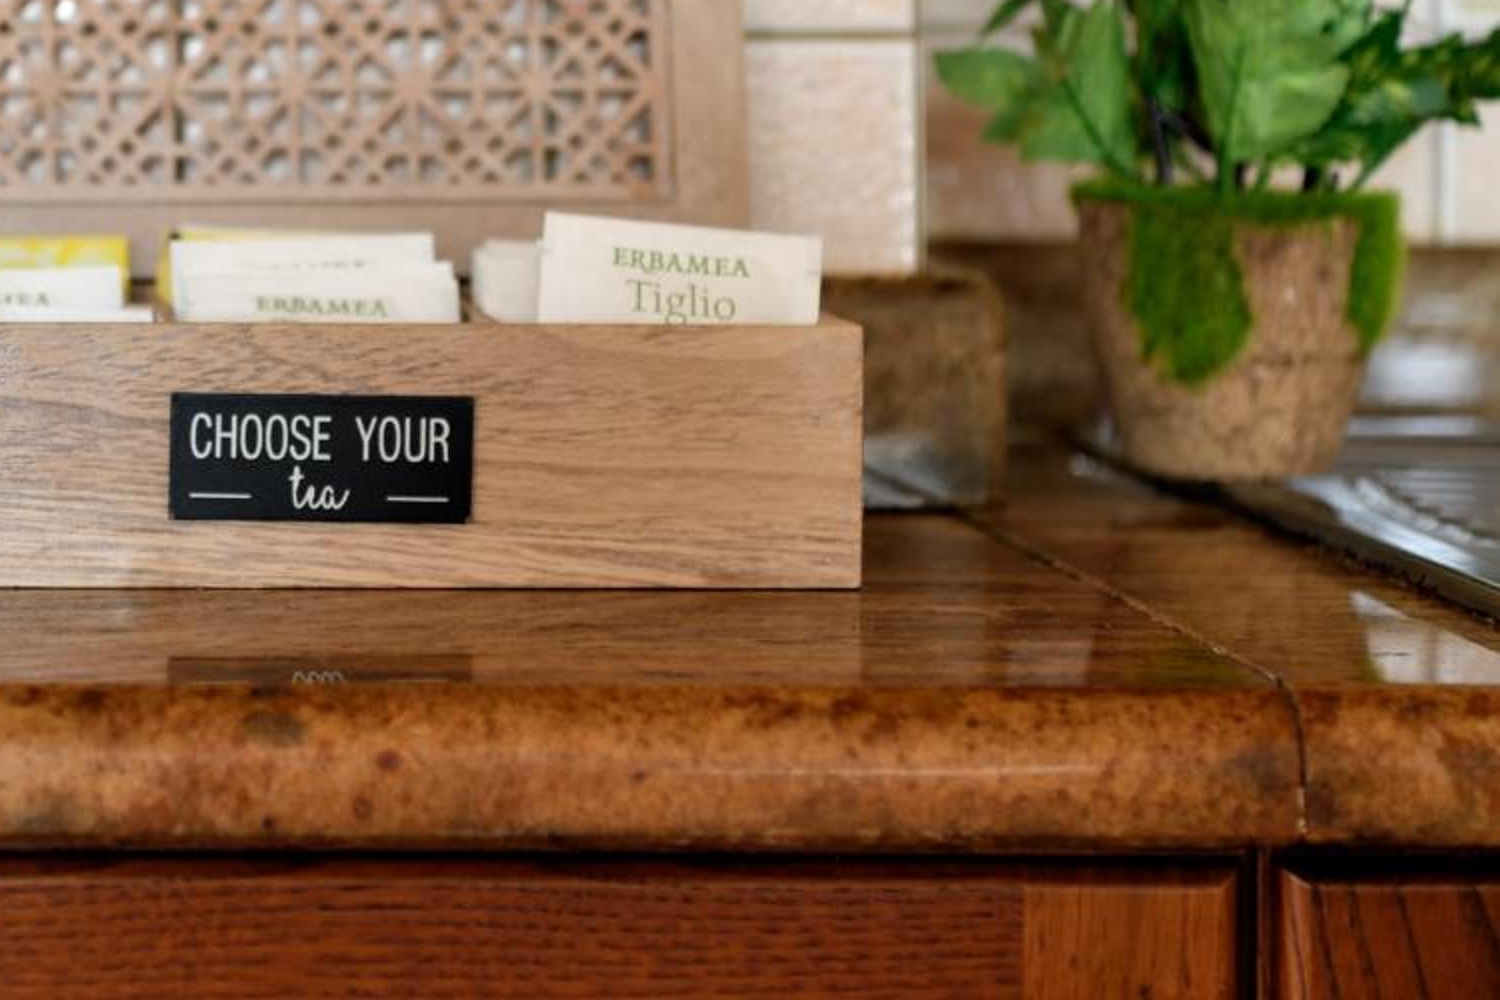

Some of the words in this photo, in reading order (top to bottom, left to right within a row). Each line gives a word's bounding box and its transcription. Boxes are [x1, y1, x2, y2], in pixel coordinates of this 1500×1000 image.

[612, 246, 751, 278] ERBAMEA
[256, 296, 388, 317] ERBAMEA
[625, 278, 737, 325] Tiglio
[190, 412, 332, 460] CHOOSE
[355, 416, 451, 463] YOUR
[288, 465, 350, 510] tea
